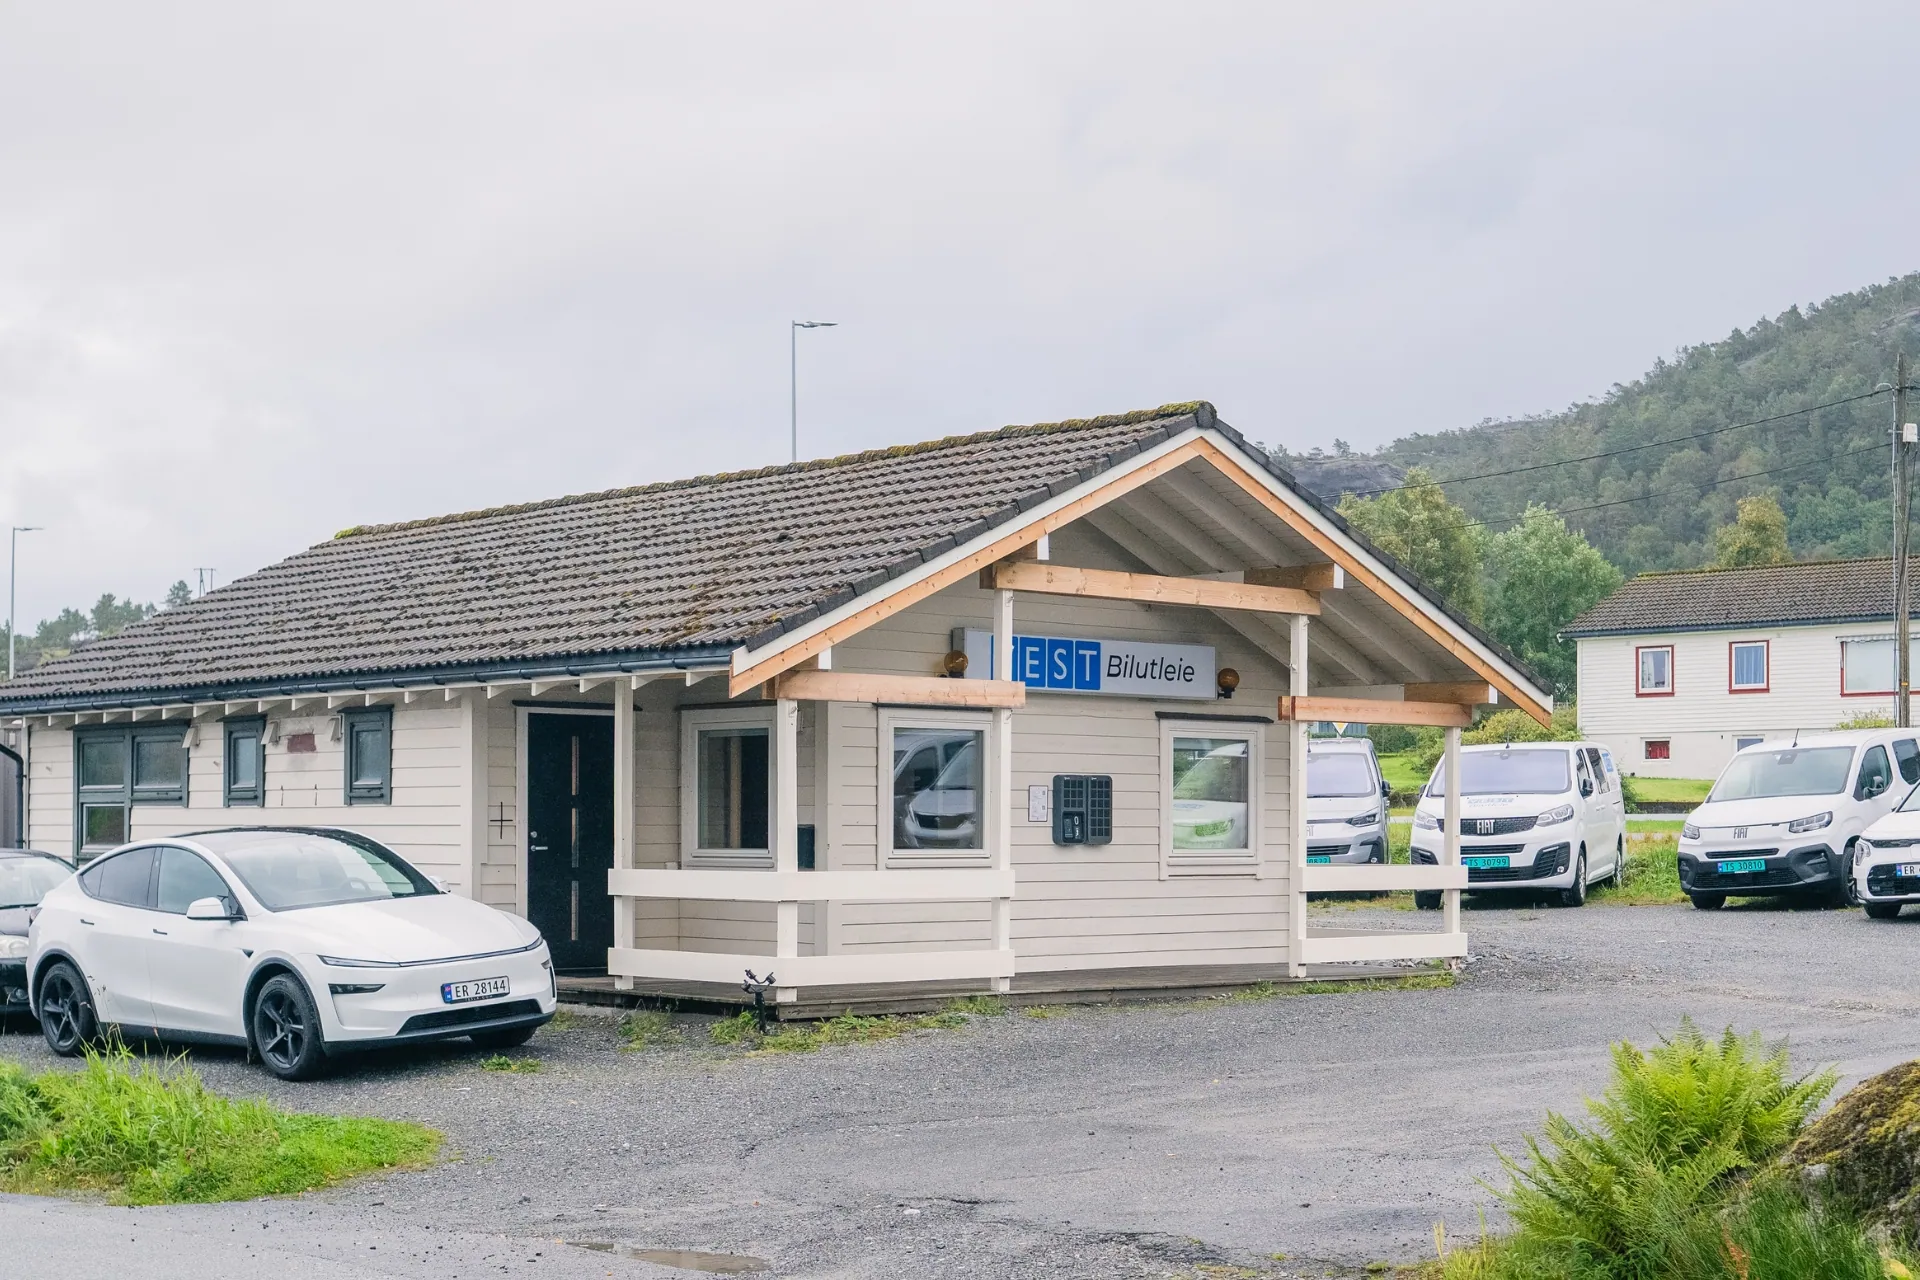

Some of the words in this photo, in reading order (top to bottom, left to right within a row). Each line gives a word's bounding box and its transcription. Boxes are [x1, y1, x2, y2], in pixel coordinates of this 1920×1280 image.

[1011, 645, 1097, 682] EST
[1106, 654, 1195, 682] Bilutleie
[1306, 825, 1315, 837] AT
[1476, 819, 1496, 834] FIAT
[1733, 827, 1749, 839] FIAT
[1468, 858, 1478, 867] TS
[1482, 858, 1507, 867] 30799
[1725, 862, 1735, 871] TS
[1738, 860, 1763, 871] 30810
[1904, 865, 1915, 875] ER
[455, 984, 469, 998] ER
[474, 979, 506, 995] 28144
